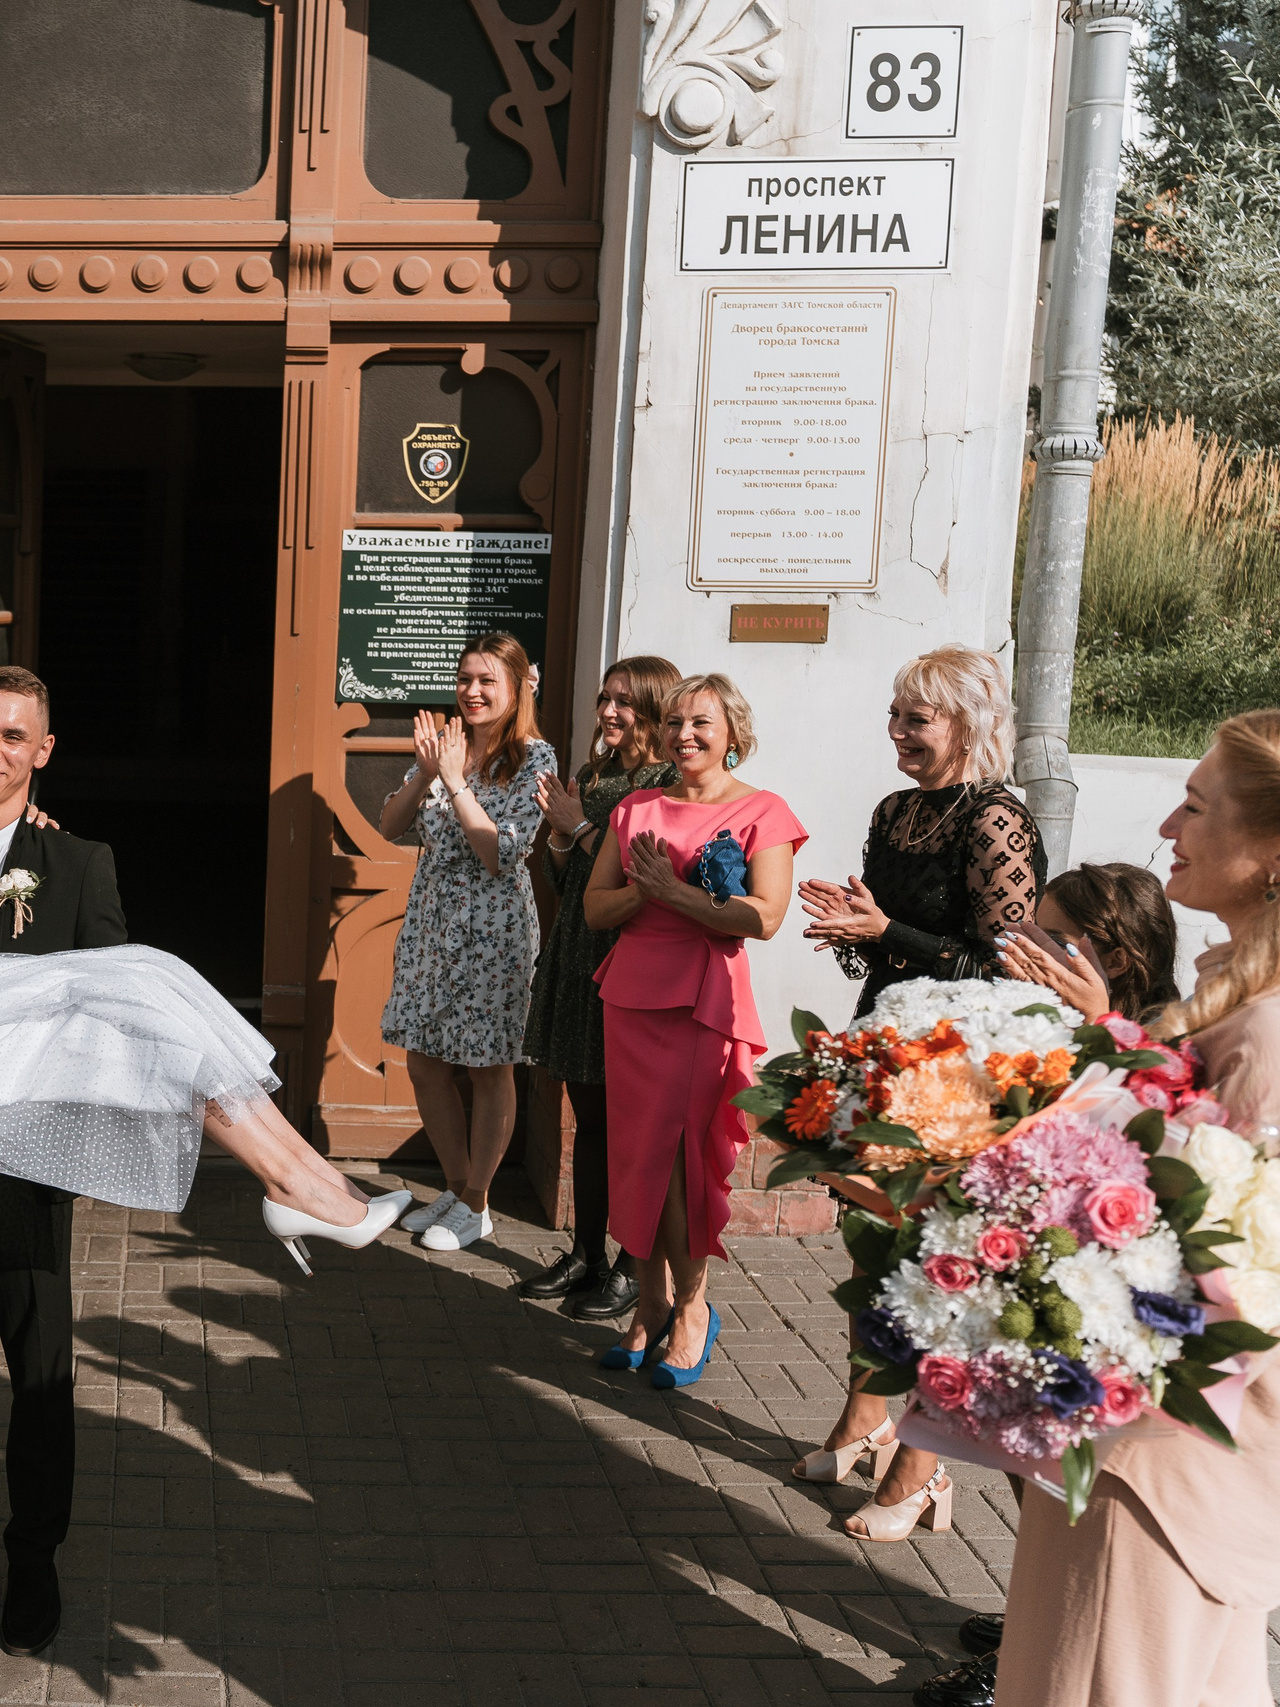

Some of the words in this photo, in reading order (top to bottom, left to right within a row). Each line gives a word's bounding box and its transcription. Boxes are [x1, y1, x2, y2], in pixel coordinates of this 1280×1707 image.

[866, 52, 942, 112] 83
[747, 176, 886, 205] проспект
[719, 213, 911, 254] ЛЕНИНА
[720, 301, 779, 310] Департамент
[781, 301, 805, 309] ЗАГС
[807, 301, 844, 309] Томской
[846, 301, 883, 309] области
[731, 324, 773, 334] Дворец
[776, 323, 868, 334] бракосочетаний
[758, 338, 797, 347] города
[801, 337, 840, 346] Томска
[753, 371, 785, 380] Прием
[788, 371, 840, 379] заявлений
[760, 385, 847, 394] государственную
[713, 399, 778, 407] регистрацию
[781, 399, 842, 407] заключения
[741, 419, 782, 427] вторник
[793, 419, 848, 427] 9.00-18.00
[723, 437, 753, 445] среда
[761, 437, 800, 445] четверг
[806, 436, 861, 444] 9.00-13.00
[716, 468, 800, 477] Государственная
[803, 469, 866, 477] регистрация
[741, 481, 802, 489] заключения
[730, 531, 772, 539] перерыв
[817, 531, 844, 539] 14.00
[346, 534, 451, 547] Уважаемые
[456, 538, 549, 551] граждане!
[360, 554, 379, 563] При
[381, 556, 442, 564] регистрации
[443, 556, 502, 564] заключения
[504, 556, 533, 566] брака
[787, 557, 852, 565] понедельник
[362, 565, 391, 573] целях
[392, 564, 451, 574] соблюдения
[453, 566, 493, 574] чистоты
[504, 567, 537, 576] городе
[759, 566, 809, 575] выходной
[369, 573, 422, 582] избежание
[424, 575, 485, 584] травматизма
[487, 577, 505, 585] при
[508, 577, 544, 585] выходе
[393, 585, 448, 593] помещения
[450, 586, 482, 594] отдела
[394, 593, 454, 603] убедительно
[398, 608, 464, 618] новобрачных
[736, 617, 758, 628] НЕ
[763, 617, 825, 629] КУРИТЬ
[390, 625, 440, 635] разбивать
[441, 626, 478, 635] бокалы
[381, 642, 446, 650] пользоваться
[380, 651, 446, 660] прилегающей
[391, 673, 431, 682] Заранее
